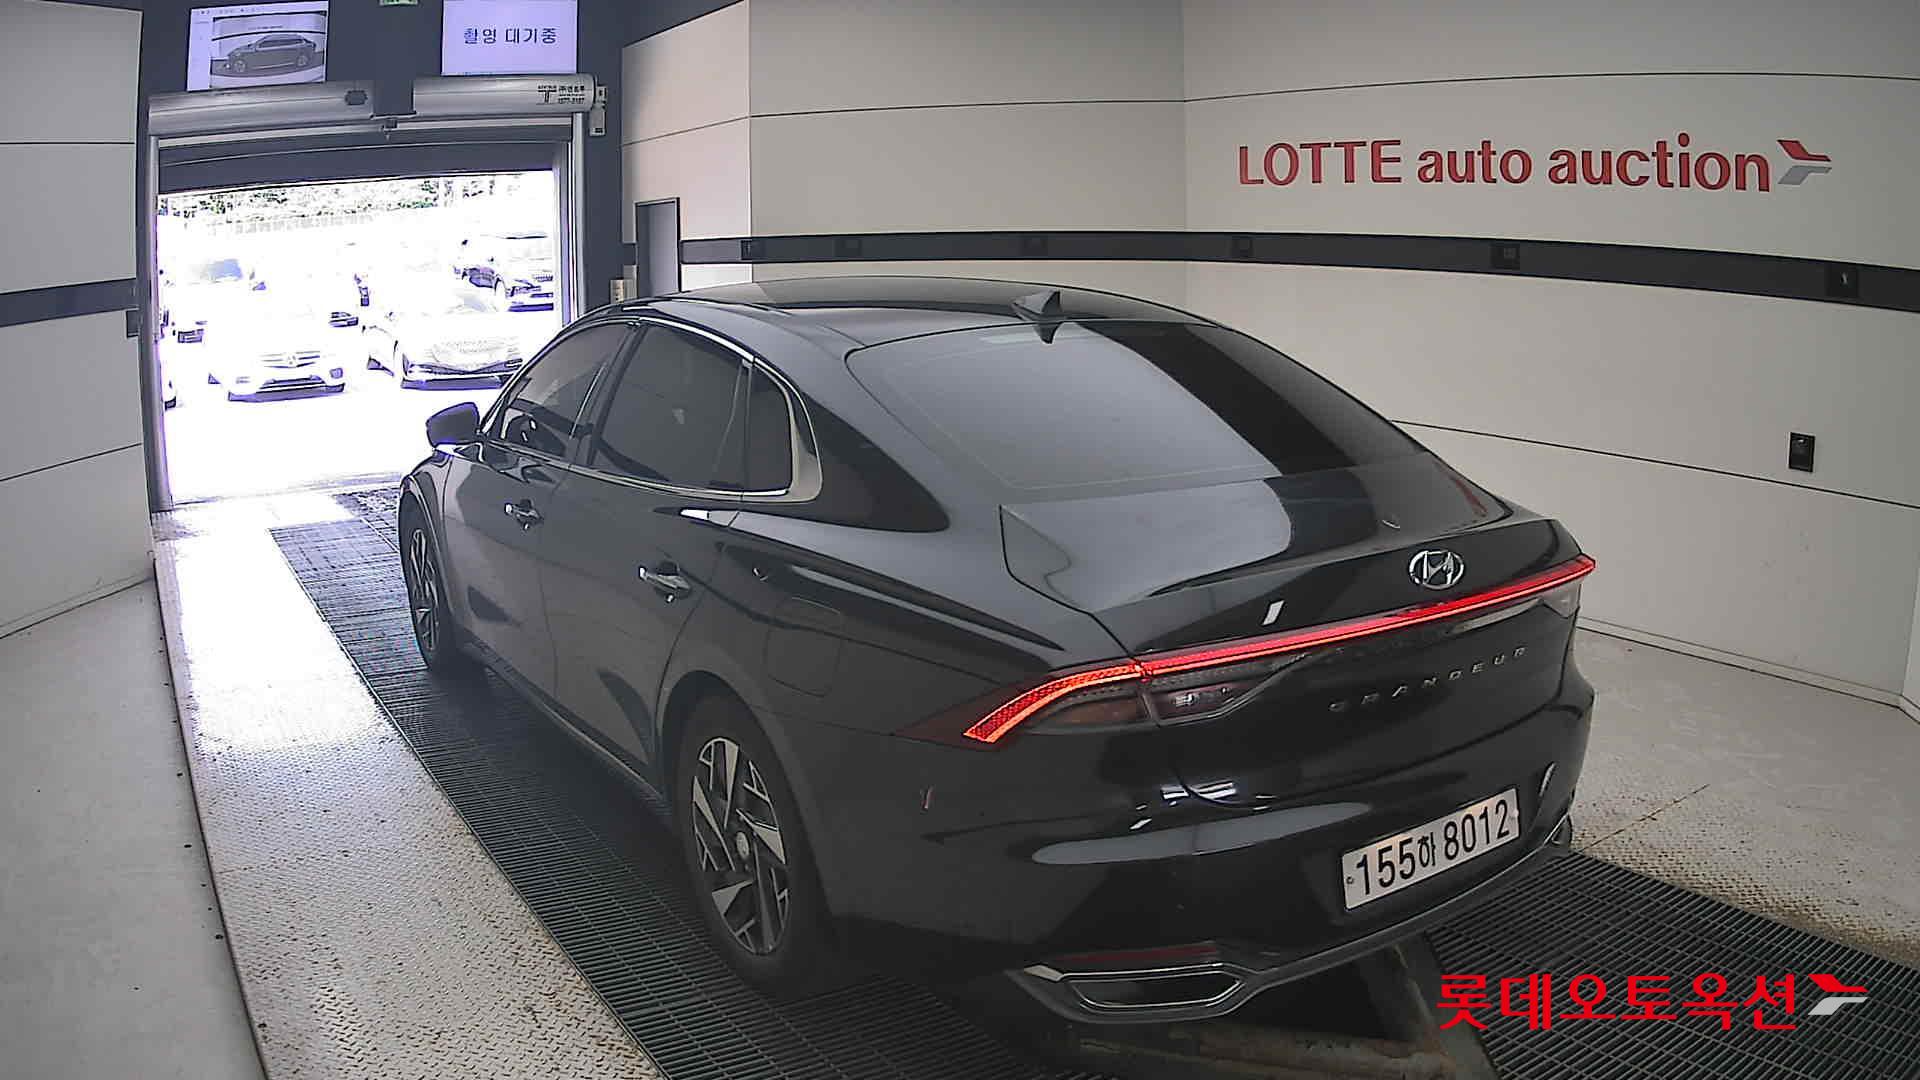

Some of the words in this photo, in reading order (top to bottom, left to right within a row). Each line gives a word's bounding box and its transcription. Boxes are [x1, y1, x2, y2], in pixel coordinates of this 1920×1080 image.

[505, 28, 557, 44] 대기중
[1239, 139, 1402, 185] LOTTE
[1417, 140, 1532, 184] auto
[1548, 132, 1770, 192] auction
[1328, 647, 1526, 712] GRANDEUR
[1443, 799, 1510, 861] 8012
